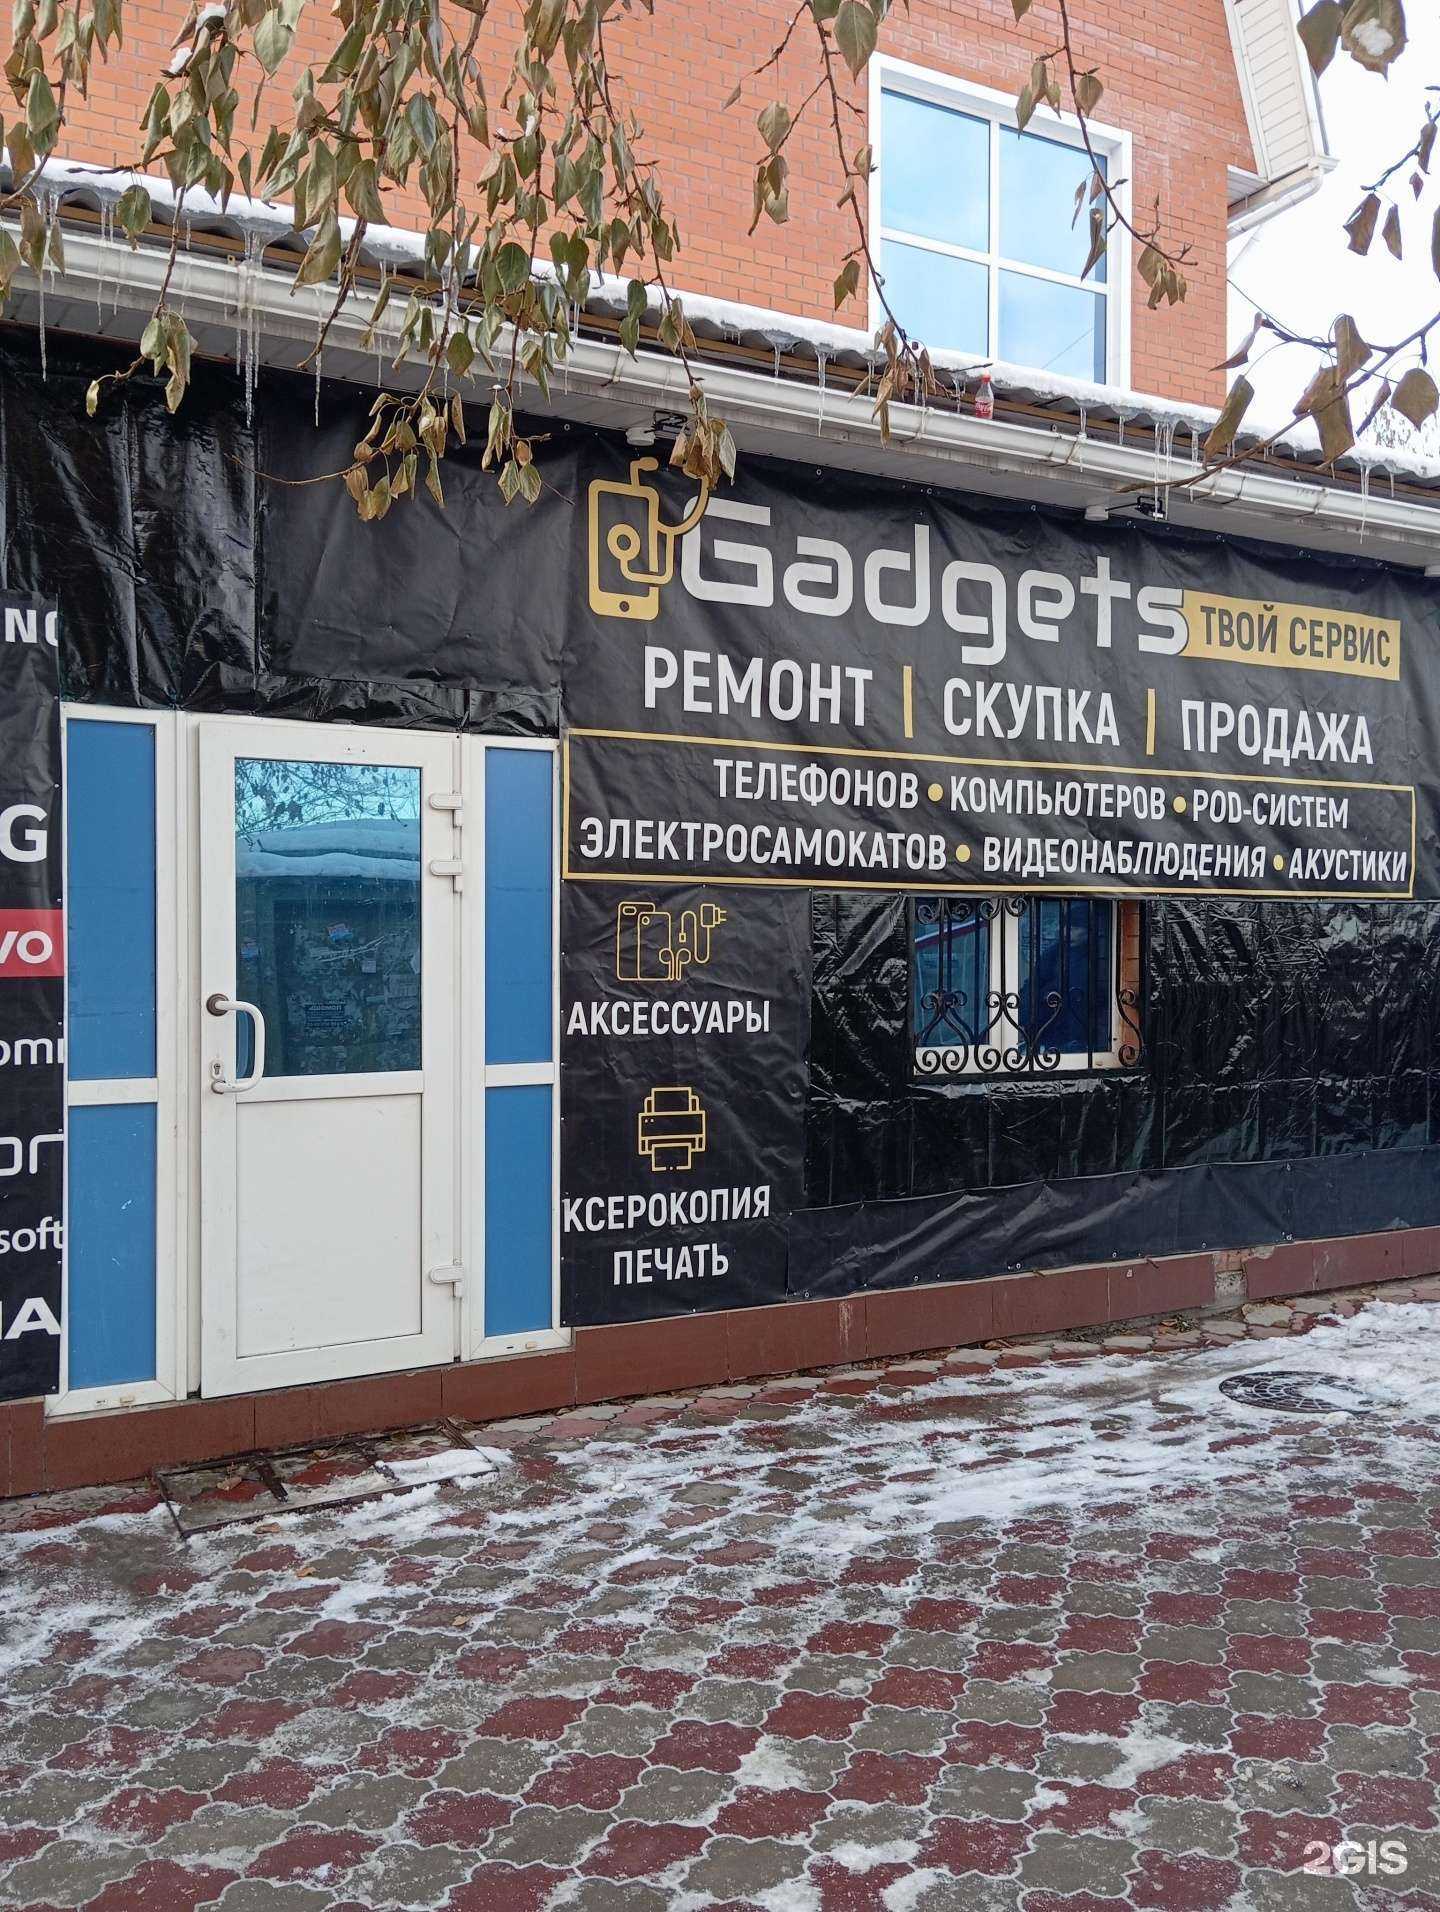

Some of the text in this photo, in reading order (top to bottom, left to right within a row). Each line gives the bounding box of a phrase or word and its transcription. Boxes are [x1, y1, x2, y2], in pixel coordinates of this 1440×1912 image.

[681, 496, 1190, 665] Gadgets
[1199, 604, 1392, 668] ТВОЙ СЕРВИС
[643, 645, 874, 727] РЕМОНТ
[943, 677, 1121, 747] СКУПКА
[1181, 699, 1375, 767] ПРОДАЖА
[713, 758, 1350, 831] ТЕЛЕФОНОВ КОМПЬЮТЕРОВ POD-СИСТЕМ
[579, 817, 1408, 883] ЭЛЕКТРОСАМОКАТОВ ВИДЕОНАБЛЮДЕНИЯ АКУСТИКИ
[566, 1000, 771, 1036] АКСЕССУАРЫ
[563, 1184, 771, 1233] КСЕРОКОПИЯ
[613, 1242, 730, 1286] ПЕЧАТЬ
